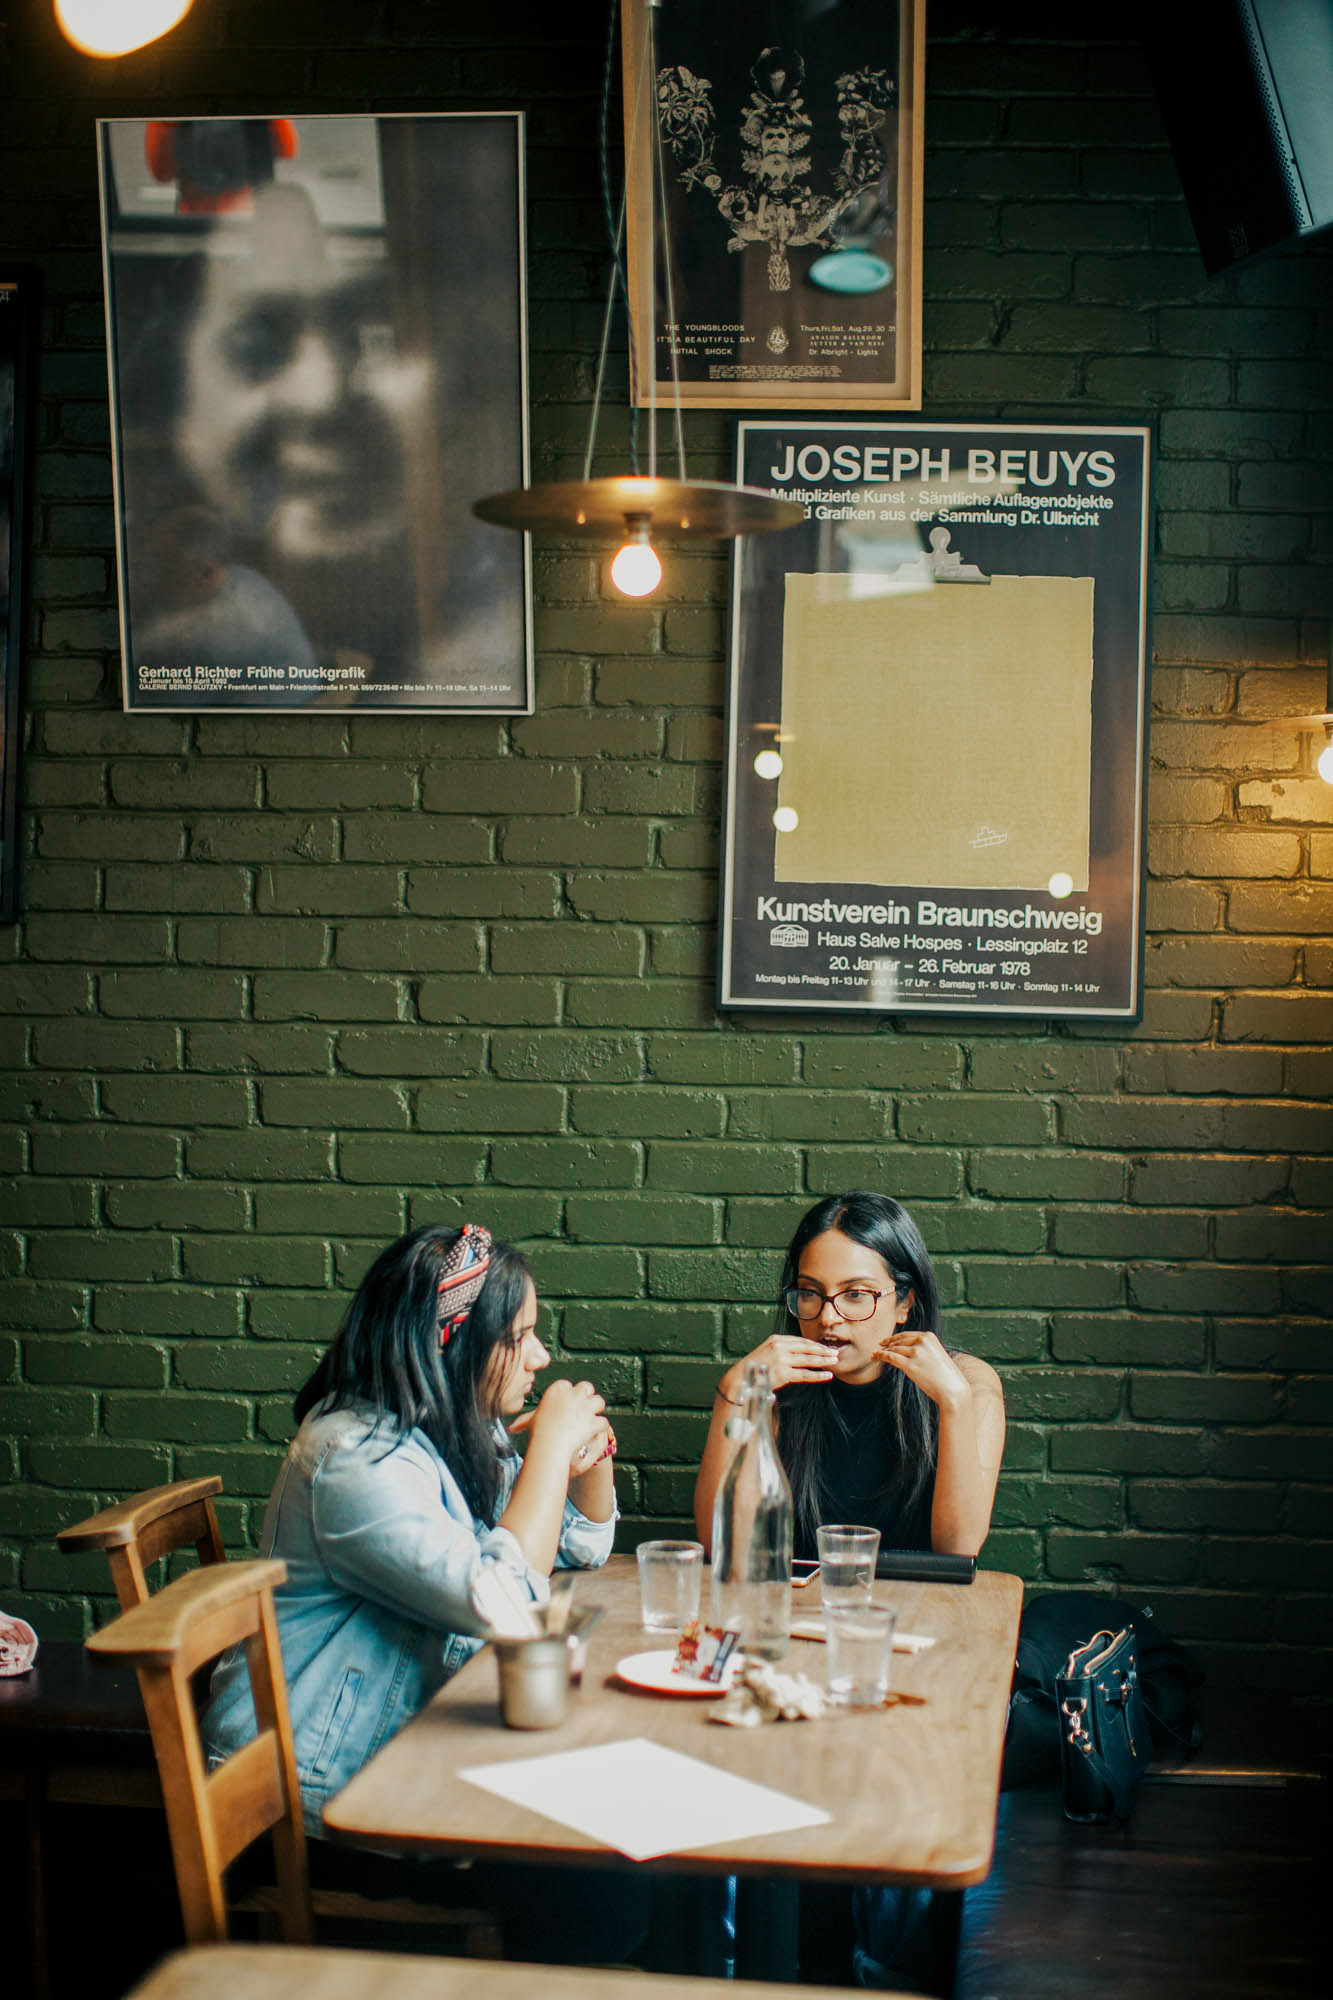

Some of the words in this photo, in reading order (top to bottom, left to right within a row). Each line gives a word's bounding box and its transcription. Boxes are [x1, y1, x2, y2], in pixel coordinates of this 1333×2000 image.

[685, 324, 745, 332] YOUNGBLOODS
[770, 444, 950, 482] JOSEPH
[967, 449, 1116, 488] BEUYS
[770, 487, 860, 504] Multiplizierte
[863, 489, 906, 504] Kunst
[919, 490, 991, 506] Sämtliche
[993, 492, 1114, 511] Auflagenobjekte
[815, 505, 876, 520] Grafiken
[879, 509, 906, 521] aus
[909, 508, 935, 522] der
[938, 508, 1017, 526] Sammlung
[1020, 510, 1040, 525] Dr.
[1043, 511, 1100, 526] Ulbricht
[138, 666, 192, 678] Gerhard
[195, 666, 243, 678] Richter
[247, 666, 285, 679] Frühe
[288, 666, 366, 681] Druckgrafik
[757, 896, 911, 925] Kunstverein
[917, 900, 1103, 936] Braunschweig
[817, 931, 856, 947] Haus
[859, 932, 900, 948] Salve
[903, 934, 962, 952] Hospes
[976, 936, 1069, 955] Lessingplatz
[1072, 939, 1088, 954] 12
[829, 956, 850, 970] 20.
[853, 956, 901, 971] Januar
[918, 959, 939, 973] 26.
[942, 960, 996, 975] Februar
[999, 960, 1031, 976] 1978
[755, 974, 786, 985] Montag
[787, 974, 800, 984] bis
[801, 975, 829, 986] Freitag
[854, 976, 869, 985] Uhr
[915, 978, 930, 987] Uhr
[939, 979, 976, 990] Samstag
[1000, 981, 1016, 990] Uhr
[1023, 982, 1058, 993] Sonntag
[1085, 984, 1101, 993] Uhr
